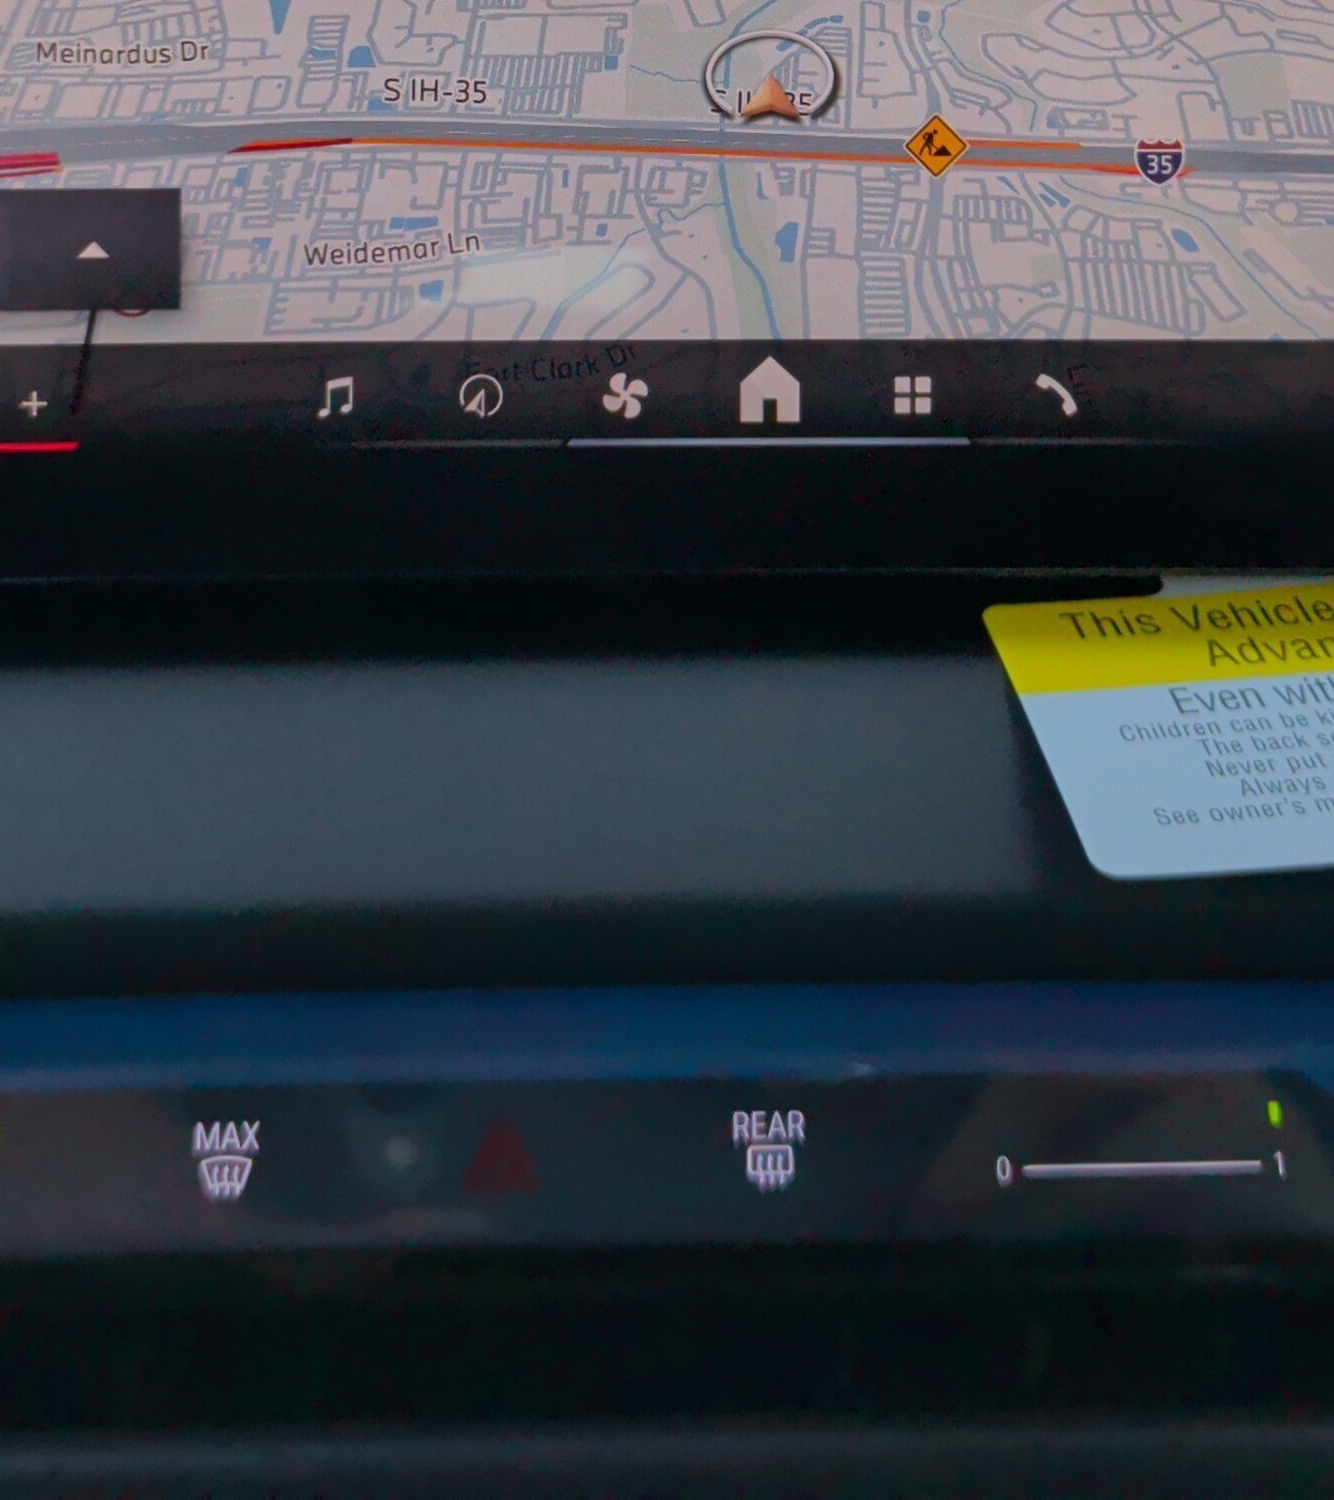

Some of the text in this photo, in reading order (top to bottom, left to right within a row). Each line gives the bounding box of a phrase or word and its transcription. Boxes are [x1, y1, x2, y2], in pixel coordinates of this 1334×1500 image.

[36, 39, 210, 65] Meinardus Dr
[384, 78, 489, 105] S IH-35
[1146, 154, 1173, 177] 35
[303, 231, 481, 267] Weidemar Ln
[1057, 609, 1163, 641] This
[1168, 685, 1268, 716] Even
[1118, 717, 1222, 743] Children
[1229, 713, 1273, 733] can
[1278, 710, 1310, 729] be
[1196, 736, 1245, 758] The
[1250, 731, 1310, 752] back
[1203, 756, 1277, 779] Never
[1286, 750, 1328, 774] put
[1239, 773, 1328, 799] Always
[1153, 805, 1201, 826] See
[1208, 797, 1307, 823] owner's
[191, 1119, 262, 1155] MAX
[731, 1109, 807, 1143] REAR
